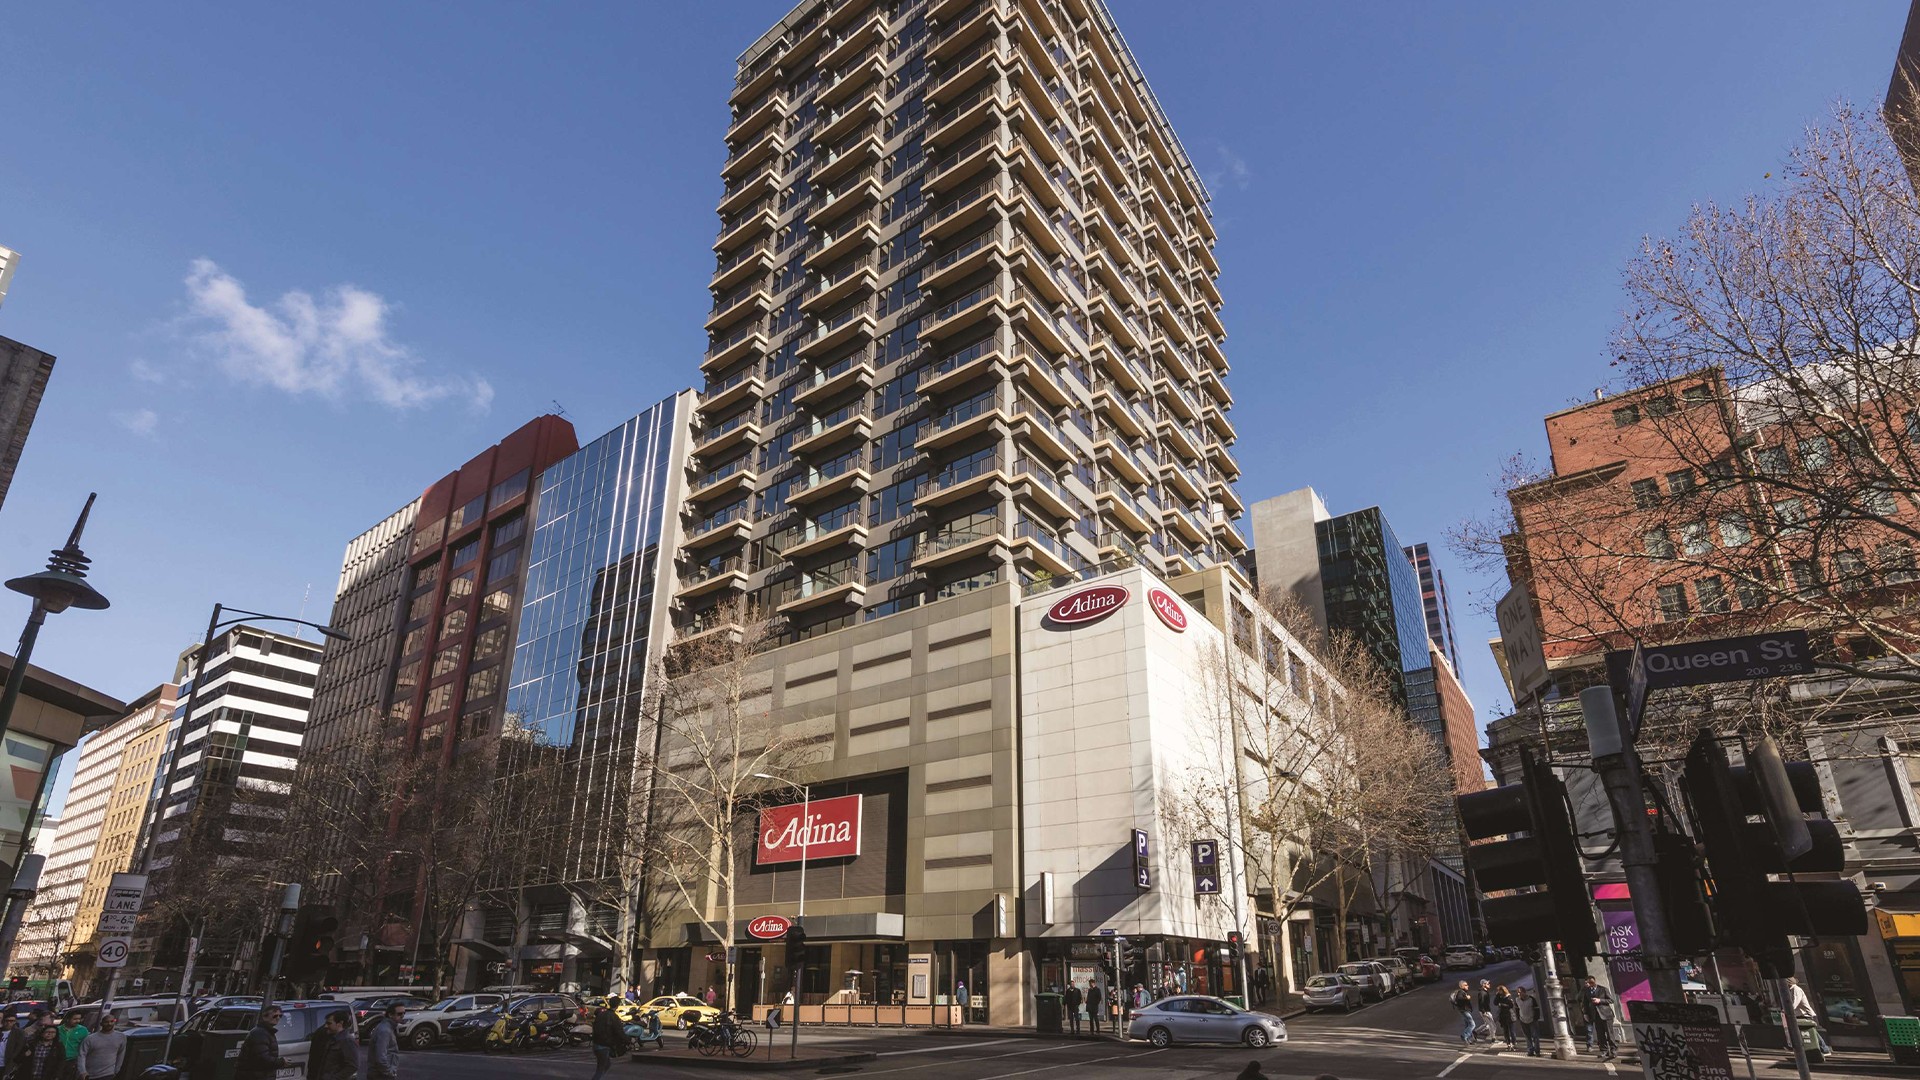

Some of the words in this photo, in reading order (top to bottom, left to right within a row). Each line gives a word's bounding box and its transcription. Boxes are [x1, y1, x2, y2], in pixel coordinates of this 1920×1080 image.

[1059, 593, 1115, 617] Adina
[1156, 595, 1184, 626] Adina
[1502, 596, 1526, 634] ONE
[1508, 626, 1535, 669] WAY
[1646, 648, 1749, 673] Queen
[1759, 639, 1798, 661] St
[1746, 666, 1769, 676] 200
[1779, 662, 1803, 673] 236
[764, 813, 852, 850] Adina
[1138, 833, 1146, 854] P
[1197, 844, 1212, 863] P
[109, 900, 137, 910] LANE
[753, 920, 784, 932] Adina
[1610, 925, 1634, 937] ASK
[1611, 937, 1629, 949] US
[102, 946, 125, 957] 40
[1617, 961, 1643, 972] NBN
[1072, 975, 1103, 983] stocktke
[1699, 1065, 1727, 1075] Fine
